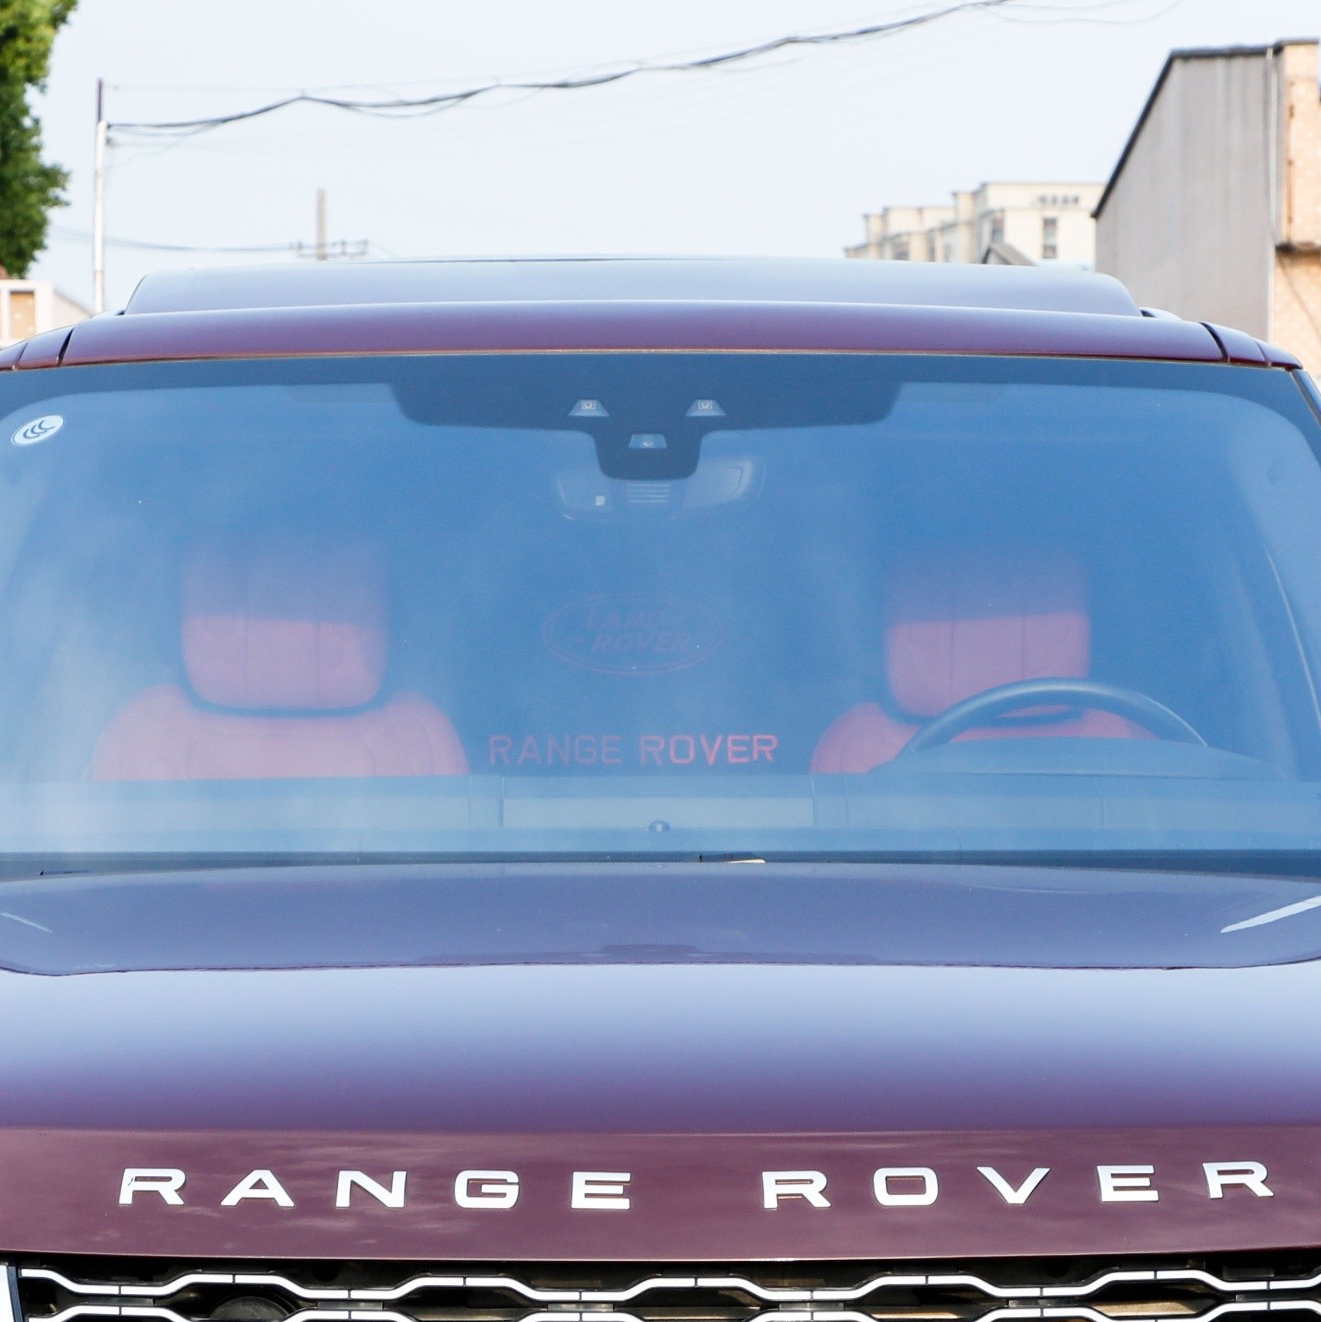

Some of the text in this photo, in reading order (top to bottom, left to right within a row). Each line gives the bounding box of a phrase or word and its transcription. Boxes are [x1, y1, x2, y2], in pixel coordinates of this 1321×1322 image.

[488, 733, 779, 767] RANGE ROVER
[118, 1161, 1274, 1210] RANGE ROVER
